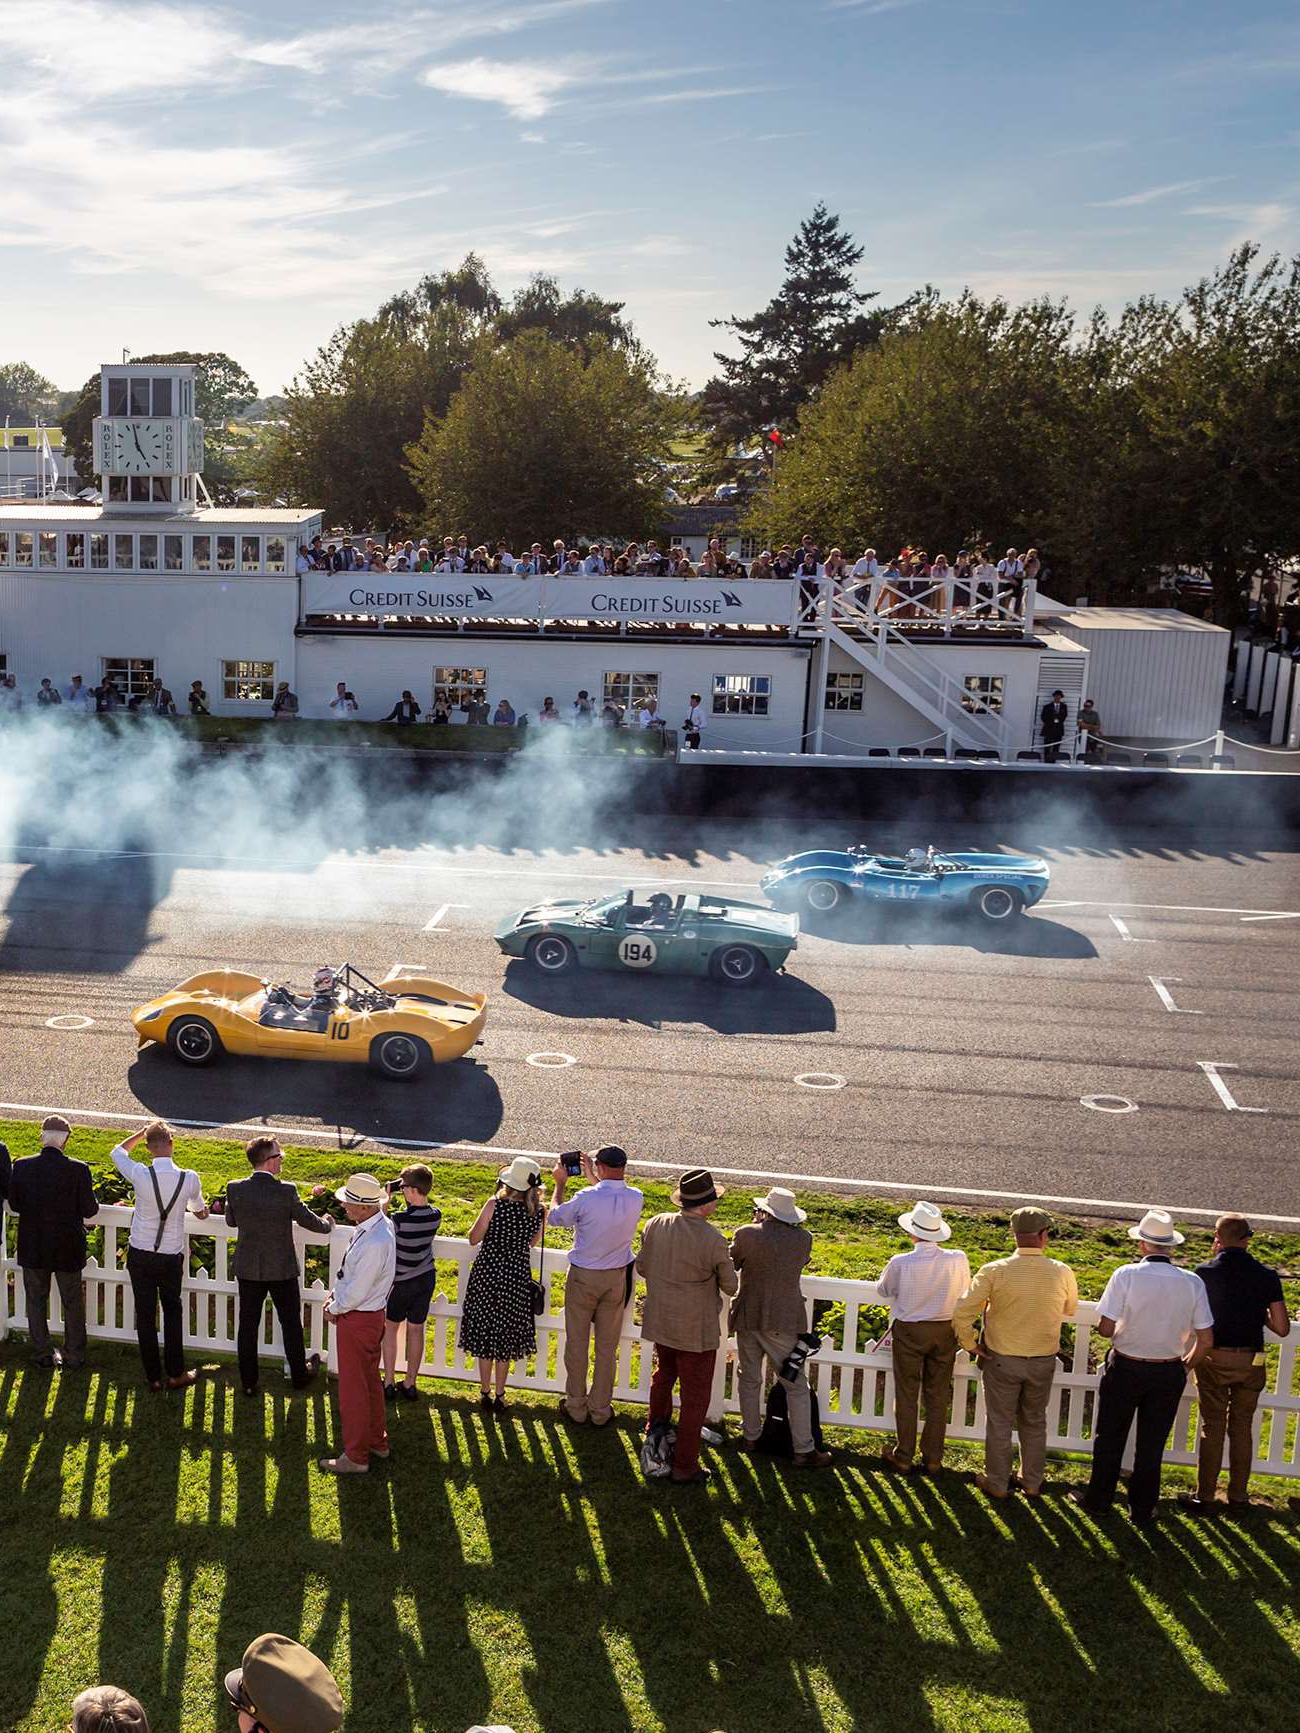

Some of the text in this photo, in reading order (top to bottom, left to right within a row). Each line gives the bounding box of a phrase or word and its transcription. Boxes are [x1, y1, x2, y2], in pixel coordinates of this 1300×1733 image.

[103, 425, 111, 468] ROLEX
[165, 425, 173, 468] ROLEX
[349, 588, 474, 608] CREDIT SUISSE
[591, 594, 722, 614] CREDIT SUISSE
[887, 884, 920, 899] 117
[623, 943, 652, 961] 194
[331, 1022, 349, 1041] 10
